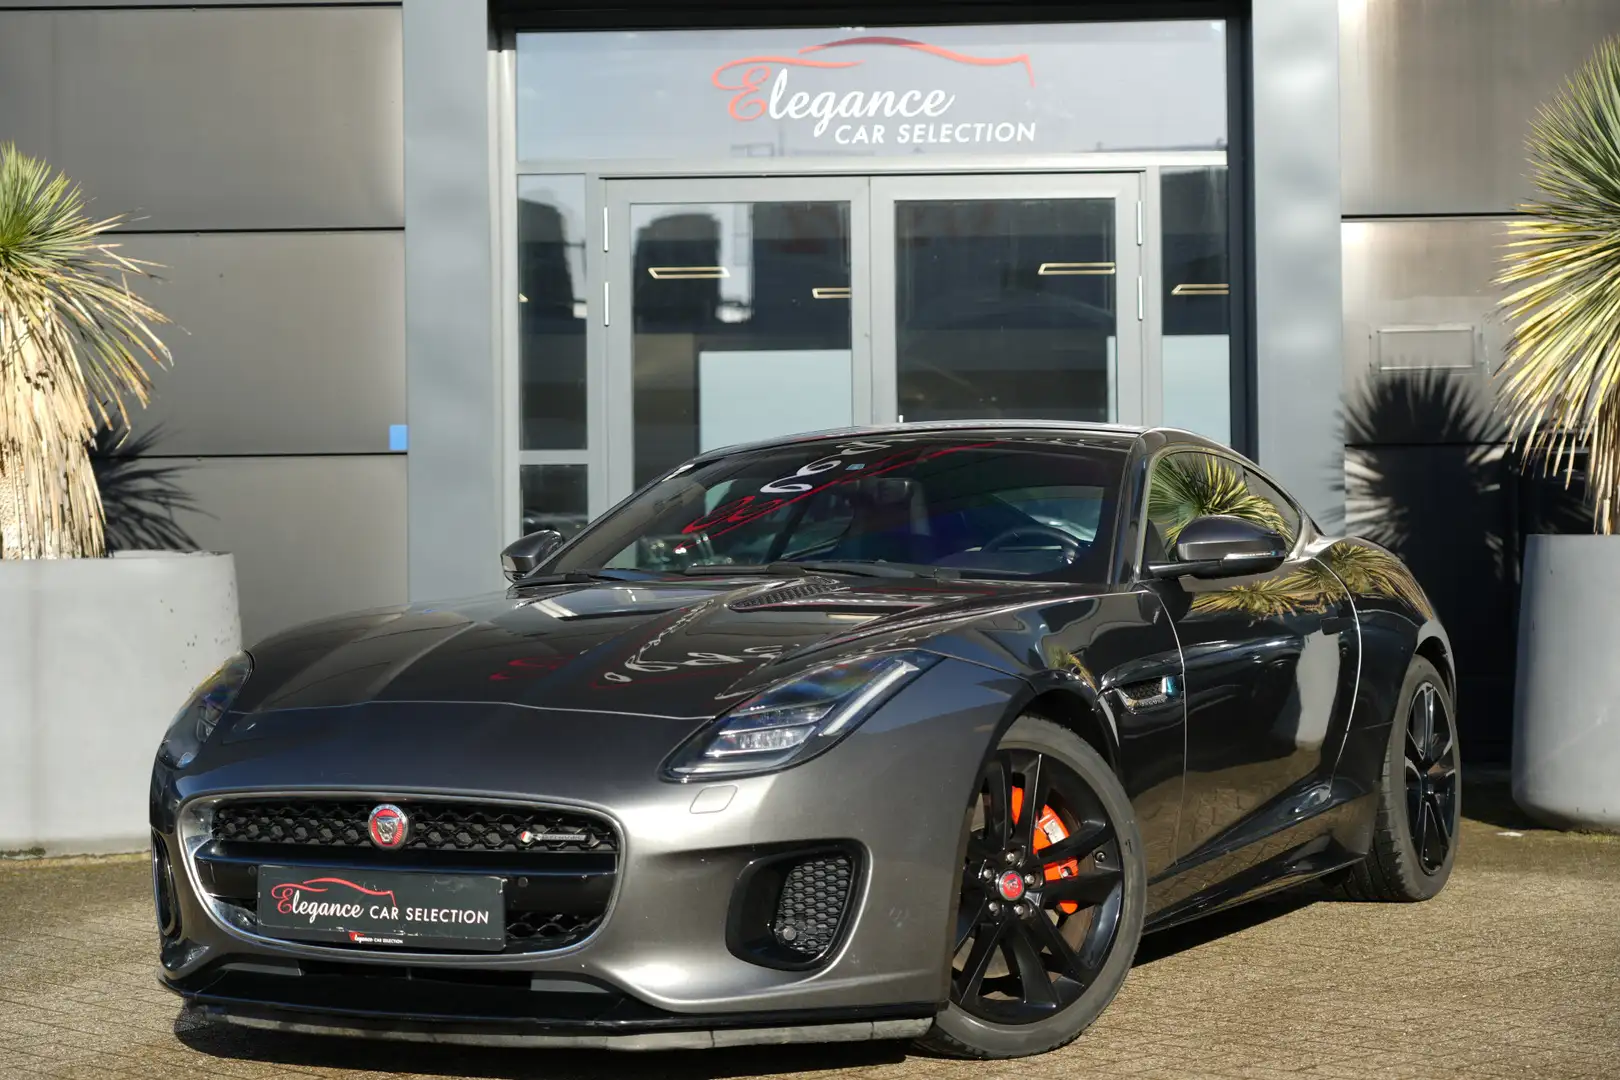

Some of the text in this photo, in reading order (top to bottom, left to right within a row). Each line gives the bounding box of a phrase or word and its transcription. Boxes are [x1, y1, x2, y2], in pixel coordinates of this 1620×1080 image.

[711, 60, 955, 137] Elegance
[835, 122, 1036, 144] CAR SELECTION
[271, 886, 489, 925] Elegance CAR SELECTION
